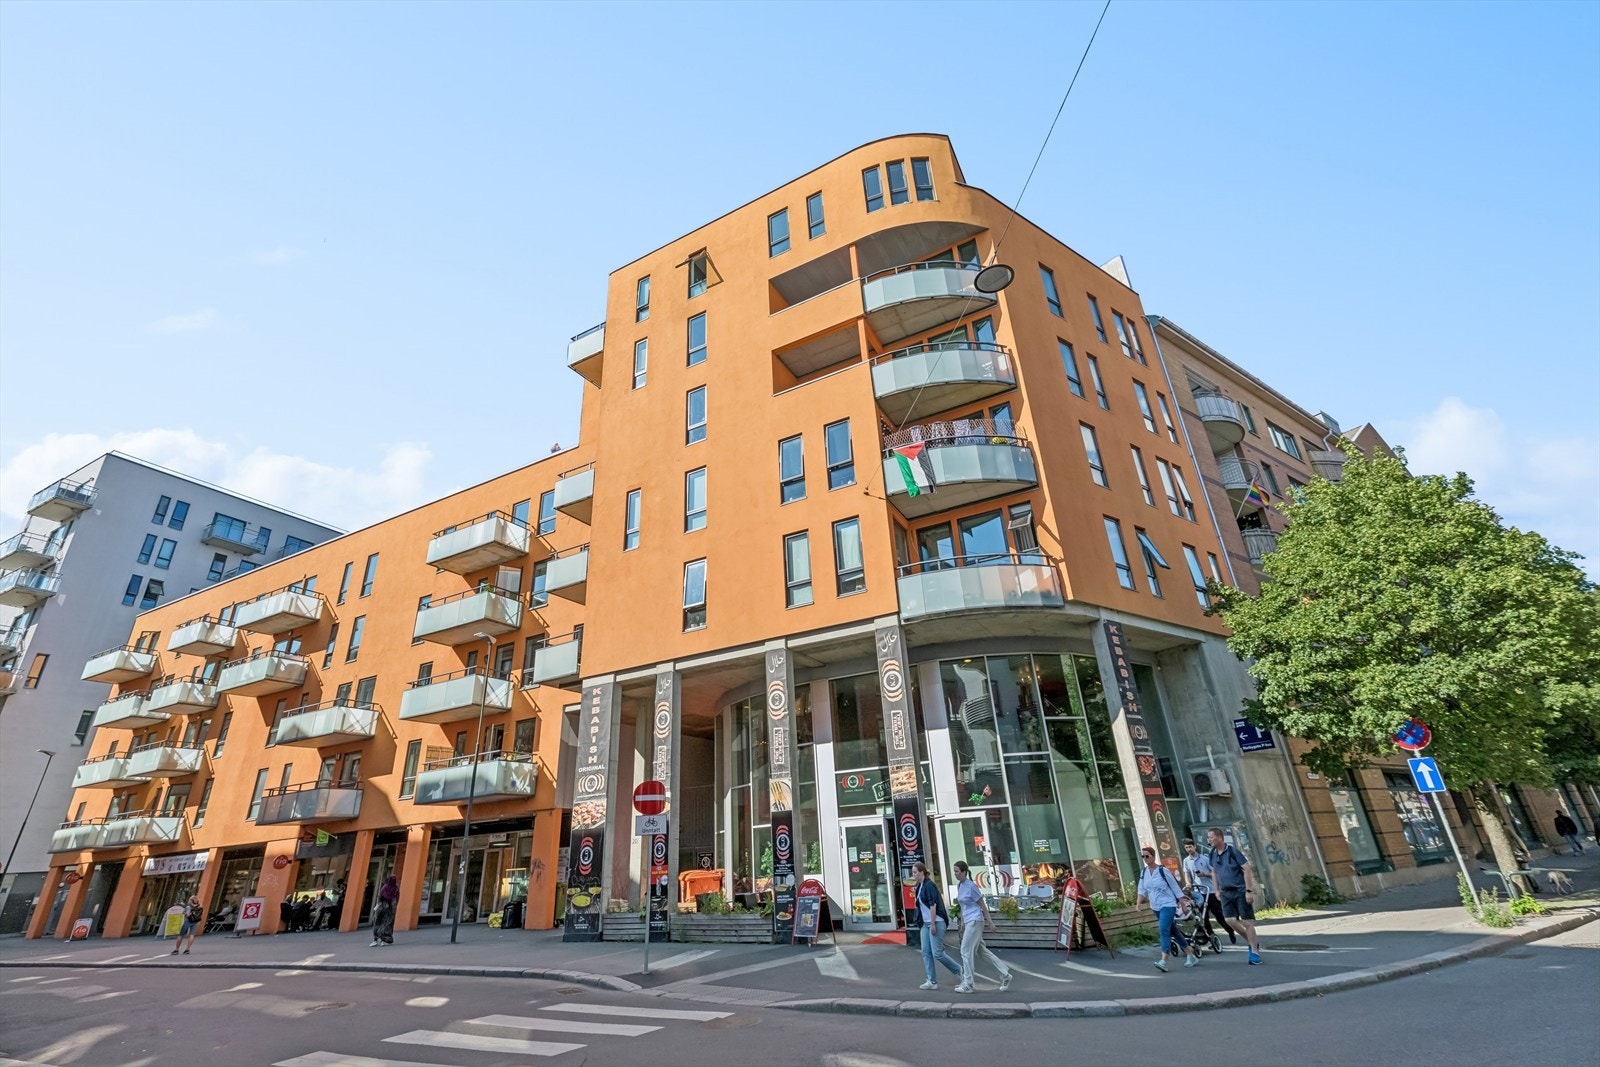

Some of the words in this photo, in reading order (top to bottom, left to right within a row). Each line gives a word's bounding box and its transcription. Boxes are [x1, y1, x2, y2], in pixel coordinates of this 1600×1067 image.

[1109, 624, 1137, 712] KEBABISH
[588, 687, 602, 764] KEBABISH
[578, 764, 606, 772] ORIGINAL
